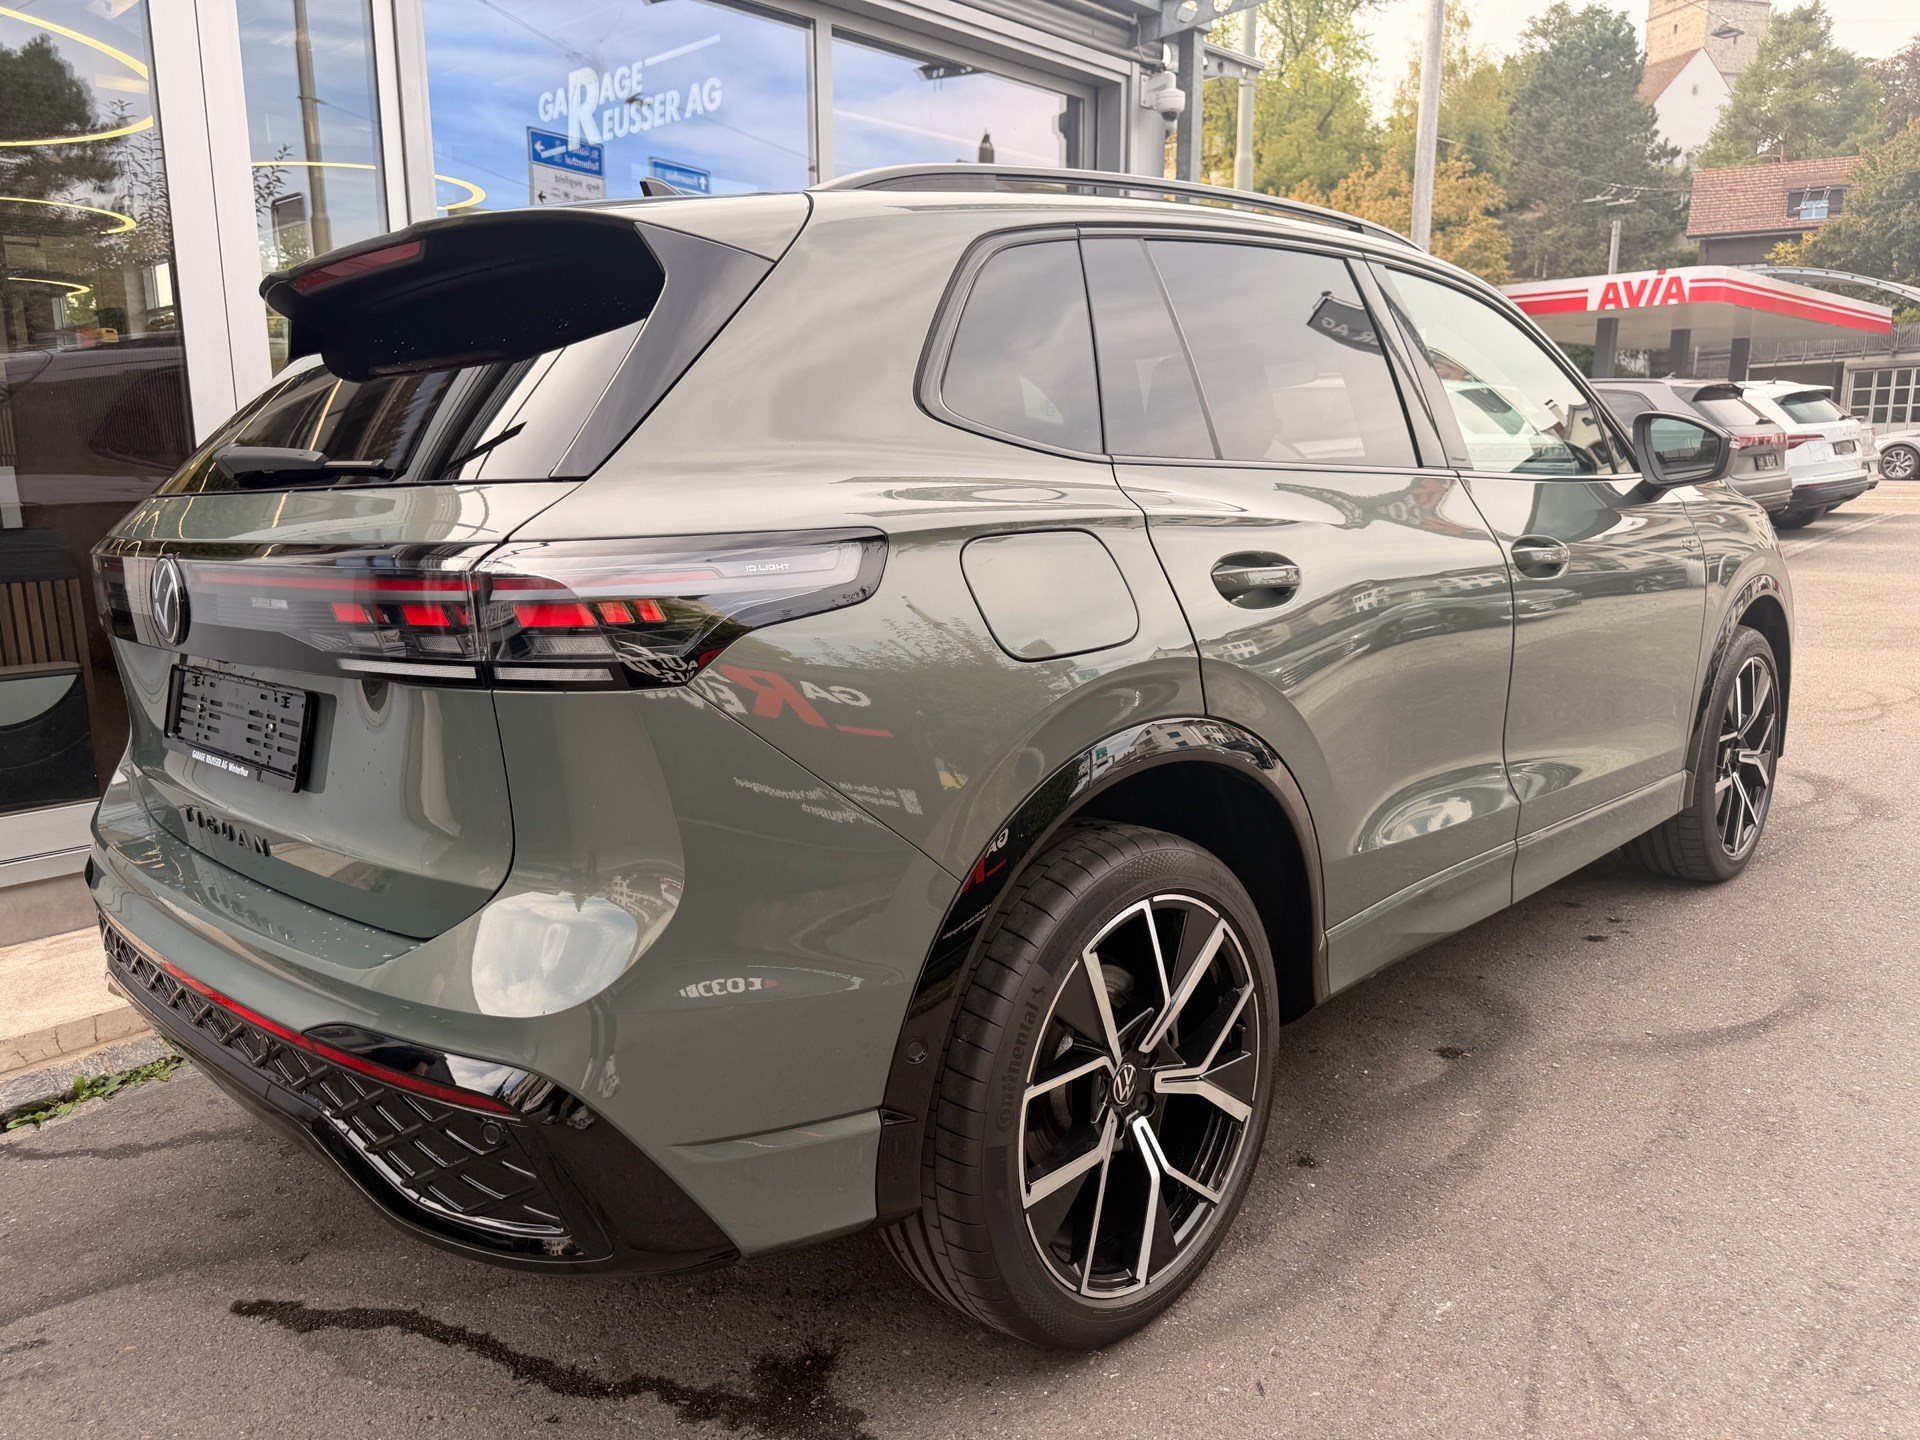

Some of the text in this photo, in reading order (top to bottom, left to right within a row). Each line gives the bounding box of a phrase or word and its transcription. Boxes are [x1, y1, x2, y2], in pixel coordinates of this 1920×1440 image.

[538, 61, 644, 151] GARAGE
[685, 76, 723, 118] AG
[1597, 269, 1688, 311] AVIA
[745, 563, 791, 572] IQ.LIGHT
[221, 760, 228, 770] AG
[186, 807, 271, 857] TIGUAN
